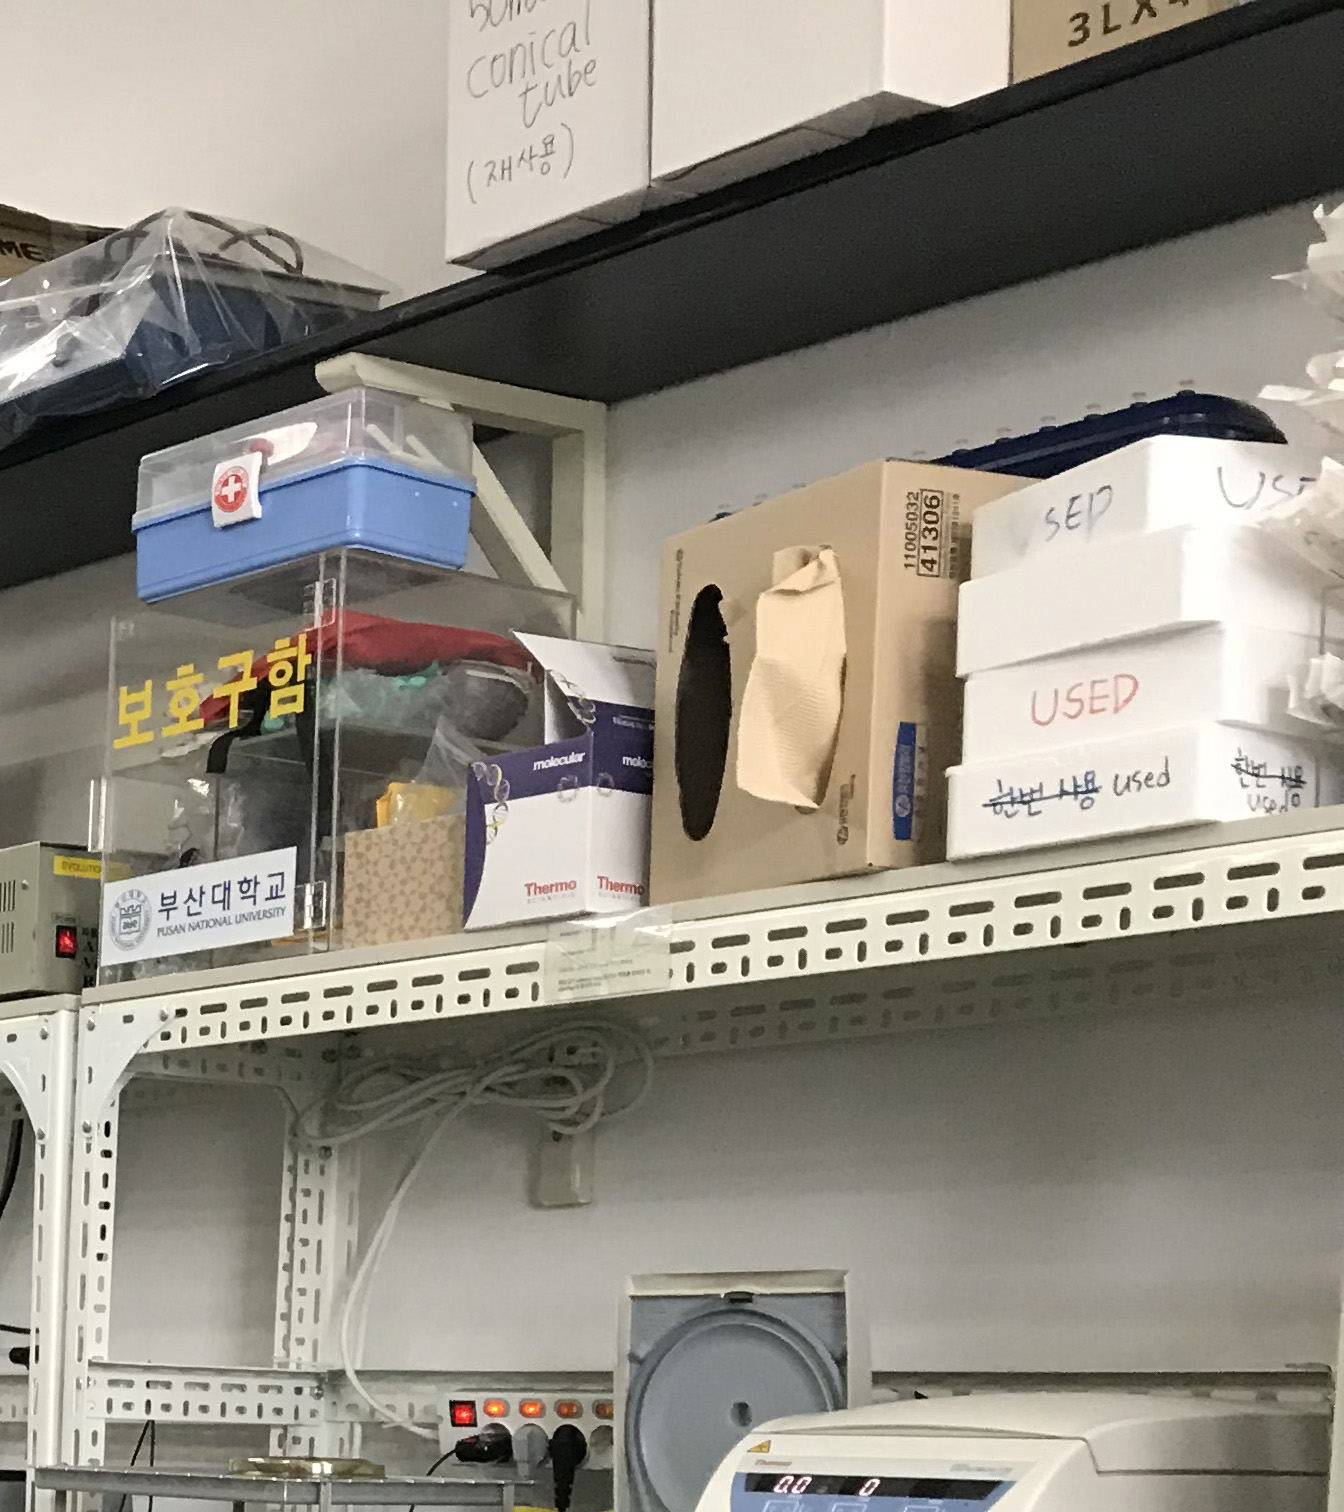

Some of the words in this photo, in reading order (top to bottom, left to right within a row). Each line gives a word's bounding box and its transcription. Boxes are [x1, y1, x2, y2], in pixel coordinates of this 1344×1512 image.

[467, 0, 591, 98] conical
[518, 58, 597, 128] tube
[467, 122, 574, 205] (재사용)
[903, 491, 919, 570] 11005032
[920, 495, 941, 573] 41306
[113, 633, 313, 749] 보호구함
[1031, 673, 1140, 728] USED
[532, 751, 586, 771] molecular
[1113, 755, 1171, 798] used
[158, 871, 286, 921] 부산대학교
[524, 879, 577, 897] Thermo
[597, 875, 645, 896] Thermo
[157, 923, 187, 938] PUSAN
[188, 914, 233, 932] NATIONAL
[235, 906, 287, 924] UNIVERSITY
[773, 1475, 812, 1494] 0.0
[859, 1478, 881, 1496] 0
